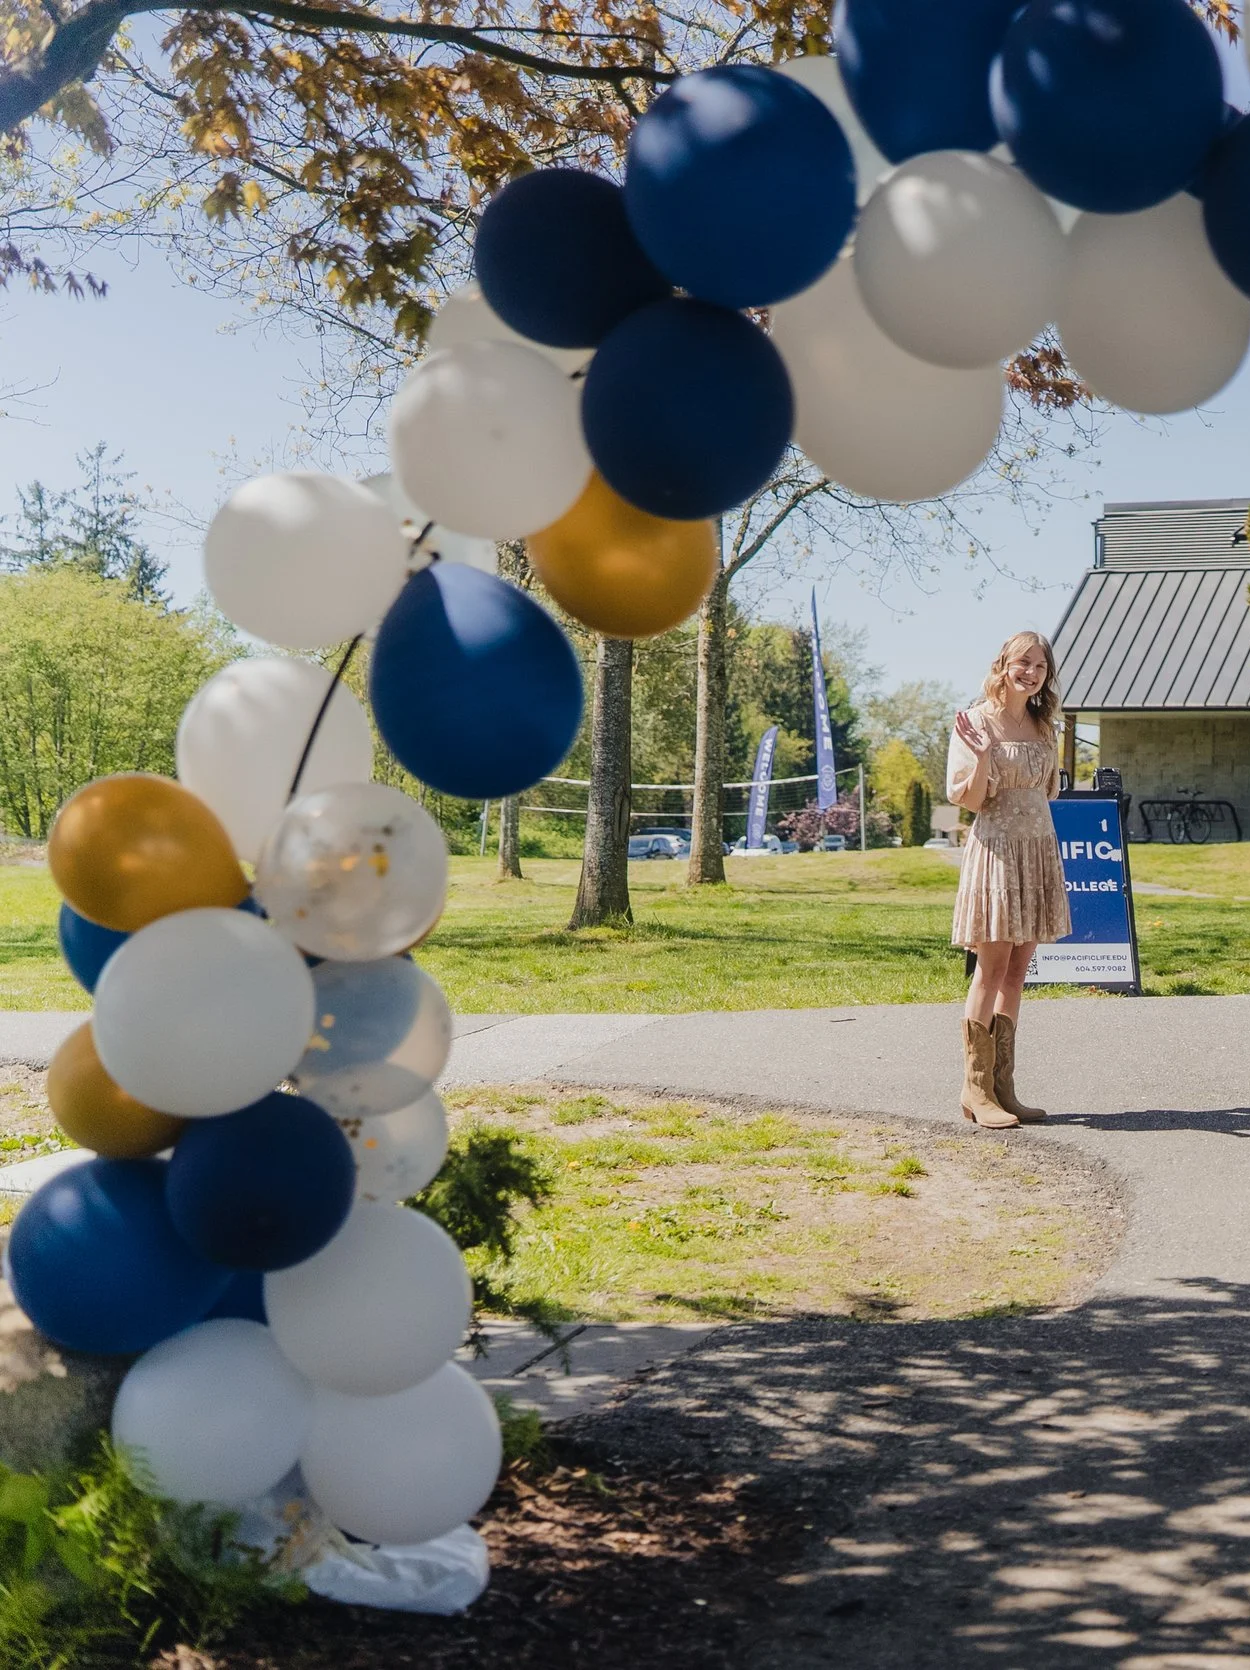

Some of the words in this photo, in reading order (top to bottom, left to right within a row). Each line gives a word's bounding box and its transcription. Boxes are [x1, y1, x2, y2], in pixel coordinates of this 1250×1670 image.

[755, 738, 773, 817] WELCOME
[1061, 841, 1113, 860] IFIC
[1065, 881, 1118, 892] OLLEGE
